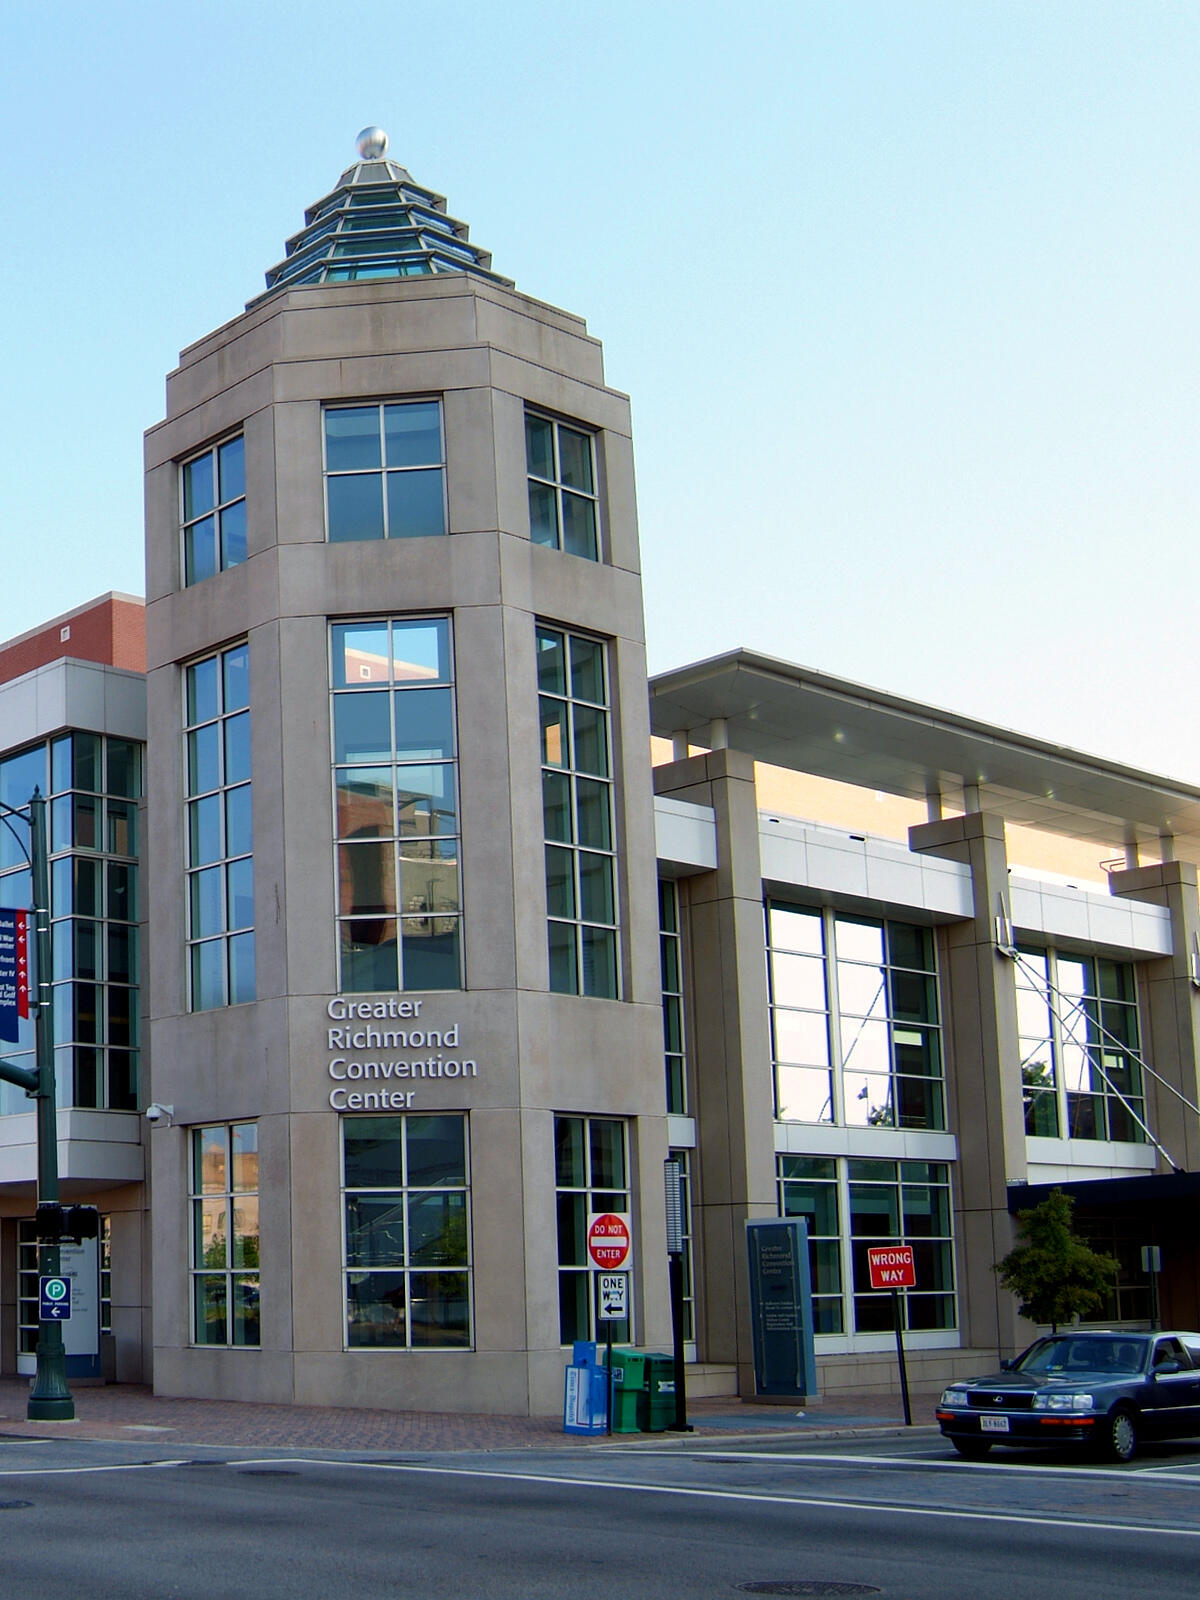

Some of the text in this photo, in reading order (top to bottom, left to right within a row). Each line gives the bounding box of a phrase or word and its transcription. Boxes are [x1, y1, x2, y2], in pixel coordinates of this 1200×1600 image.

[3, 934, 14, 942] War
[5, 983, 15, 991] Tee
[3, 991, 16, 999] Golf
[327, 998, 422, 1020] Greater
[327, 1023, 460, 1050] Richmond
[328, 1054, 478, 1081] Convention
[328, 1088, 416, 1111] Center
[594, 1224, 623, 1234] DO NOT
[596, 1248, 621, 1259] ENTER
[871, 1252, 911, 1266] WRONG
[880, 1269, 904, 1282] WAY
[602, 1278, 624, 1289] ONE
[52, 1284, 61, 1296] P
